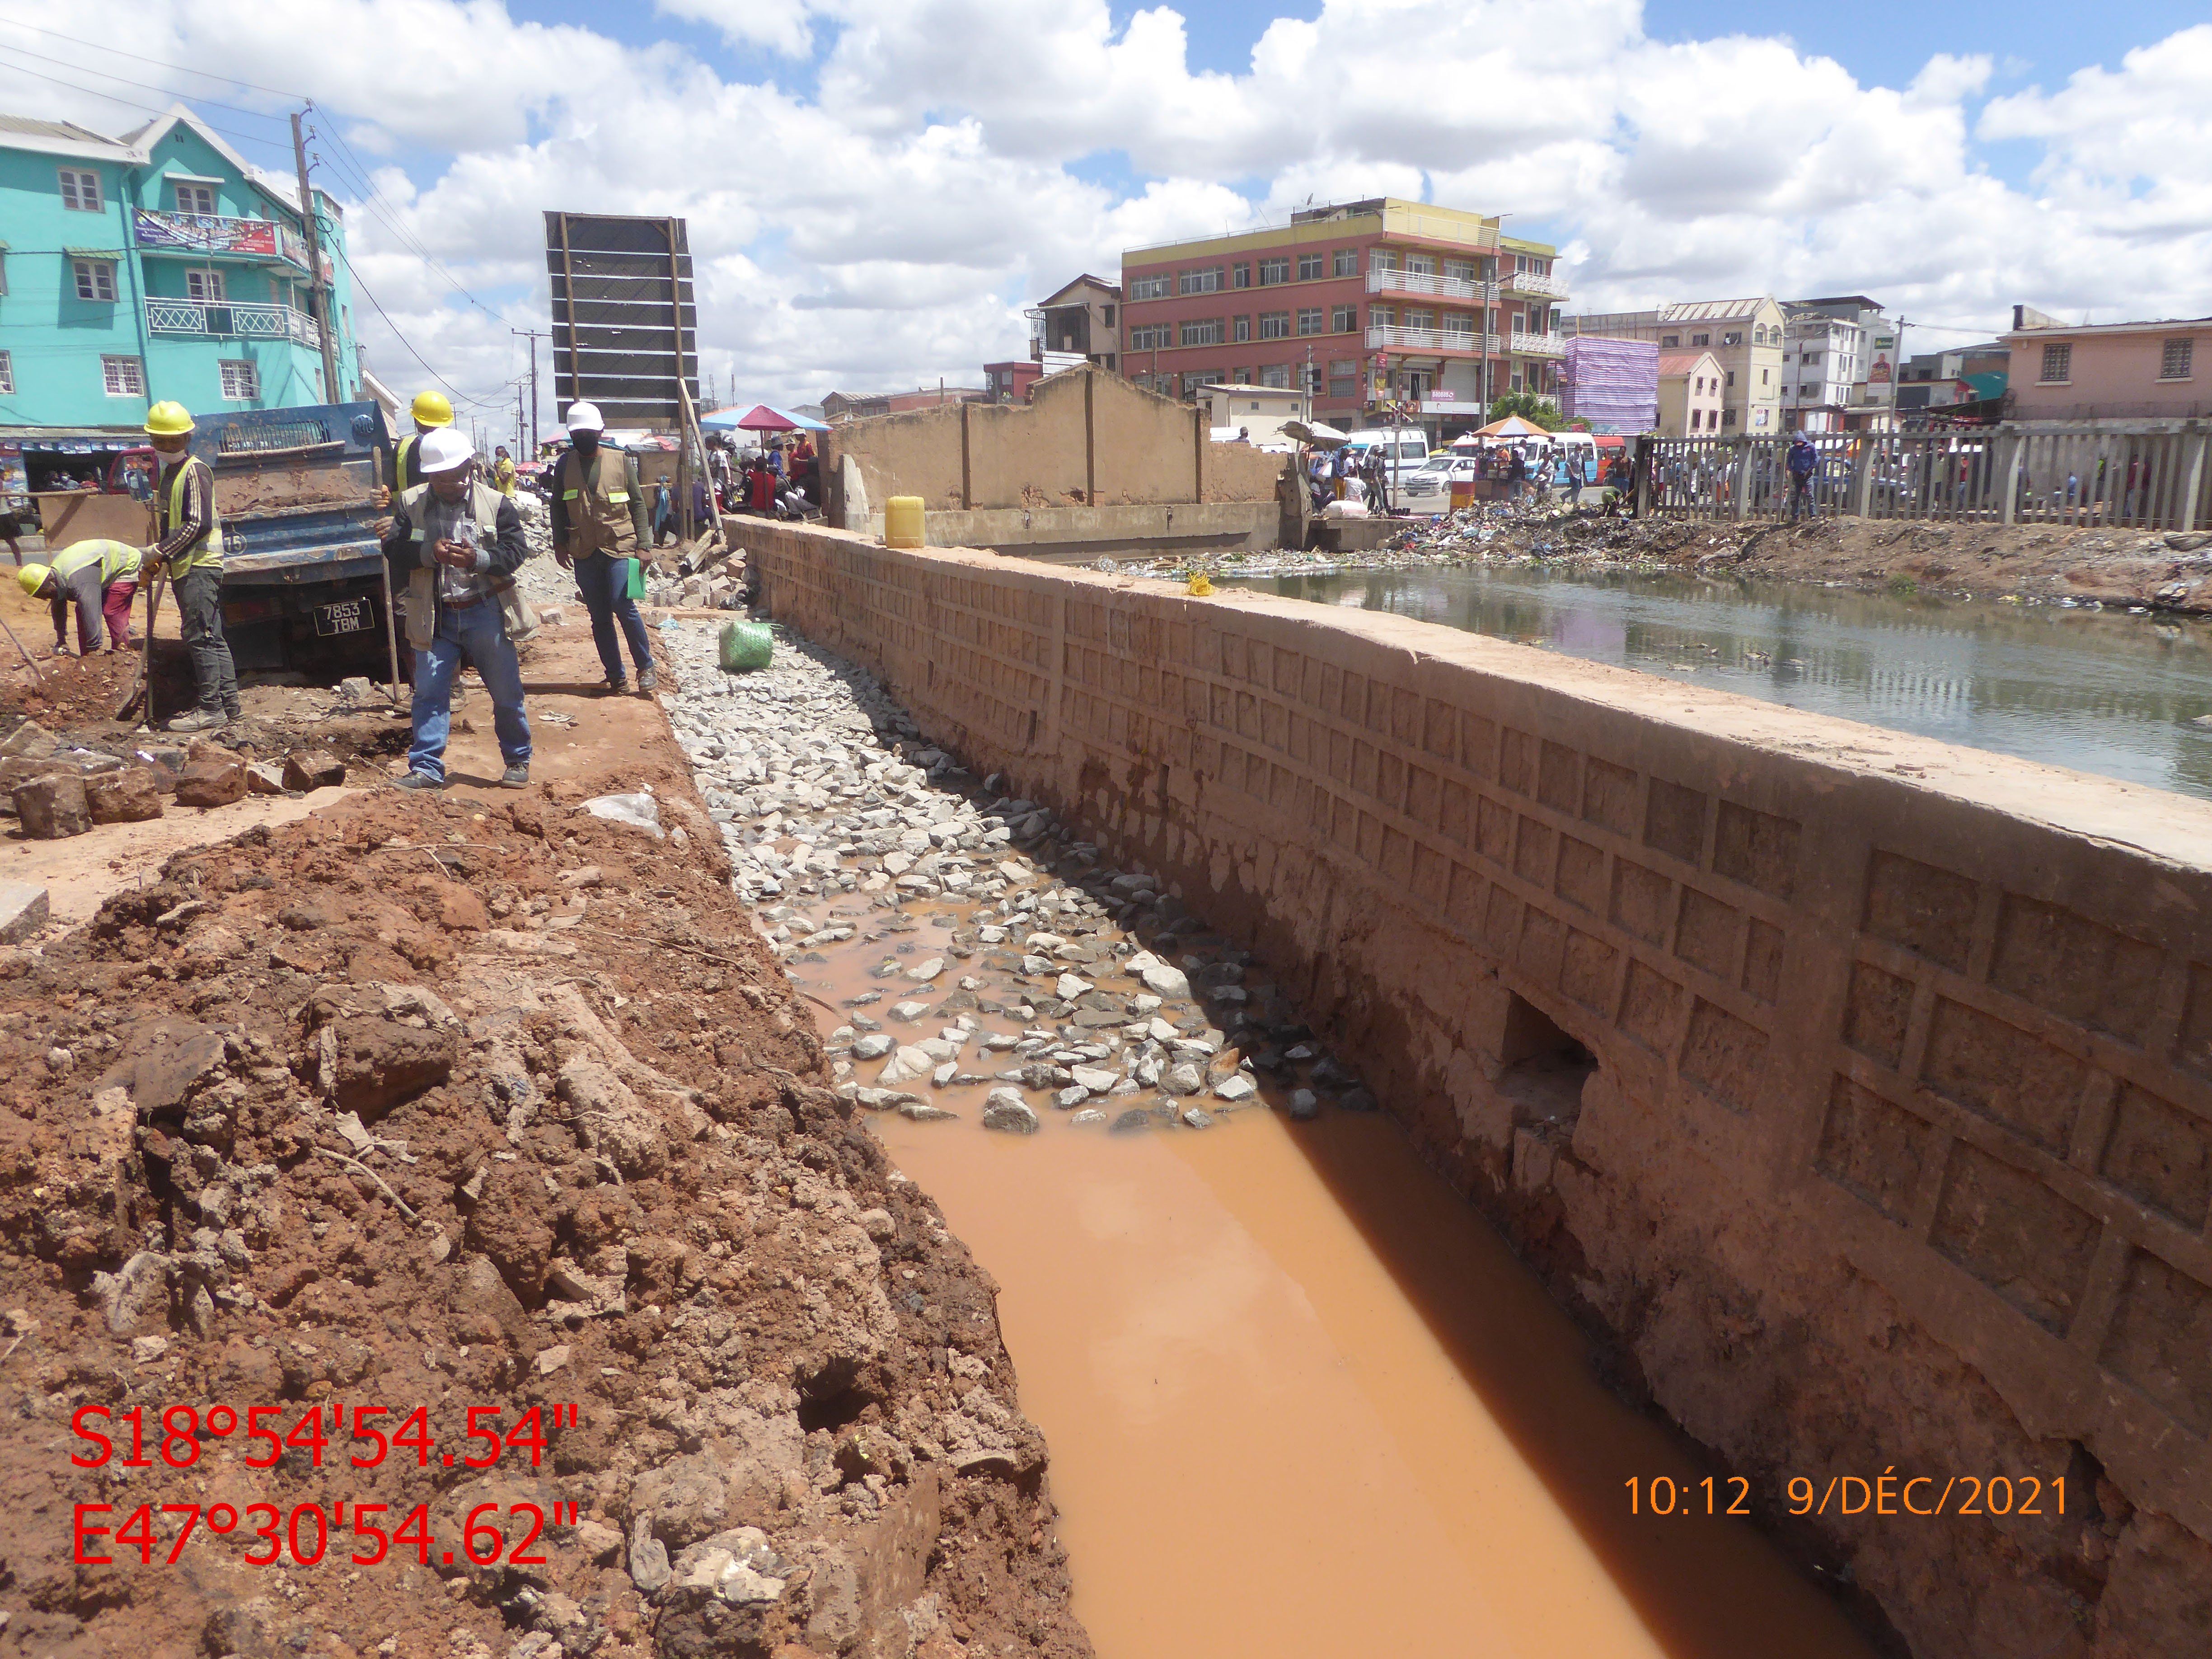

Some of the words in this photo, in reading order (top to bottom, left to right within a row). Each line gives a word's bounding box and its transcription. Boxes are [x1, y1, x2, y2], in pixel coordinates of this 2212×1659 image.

[224, 535, 242, 552] 75
[323, 602, 360, 620] 7853
[332, 616, 360, 632] TBM
